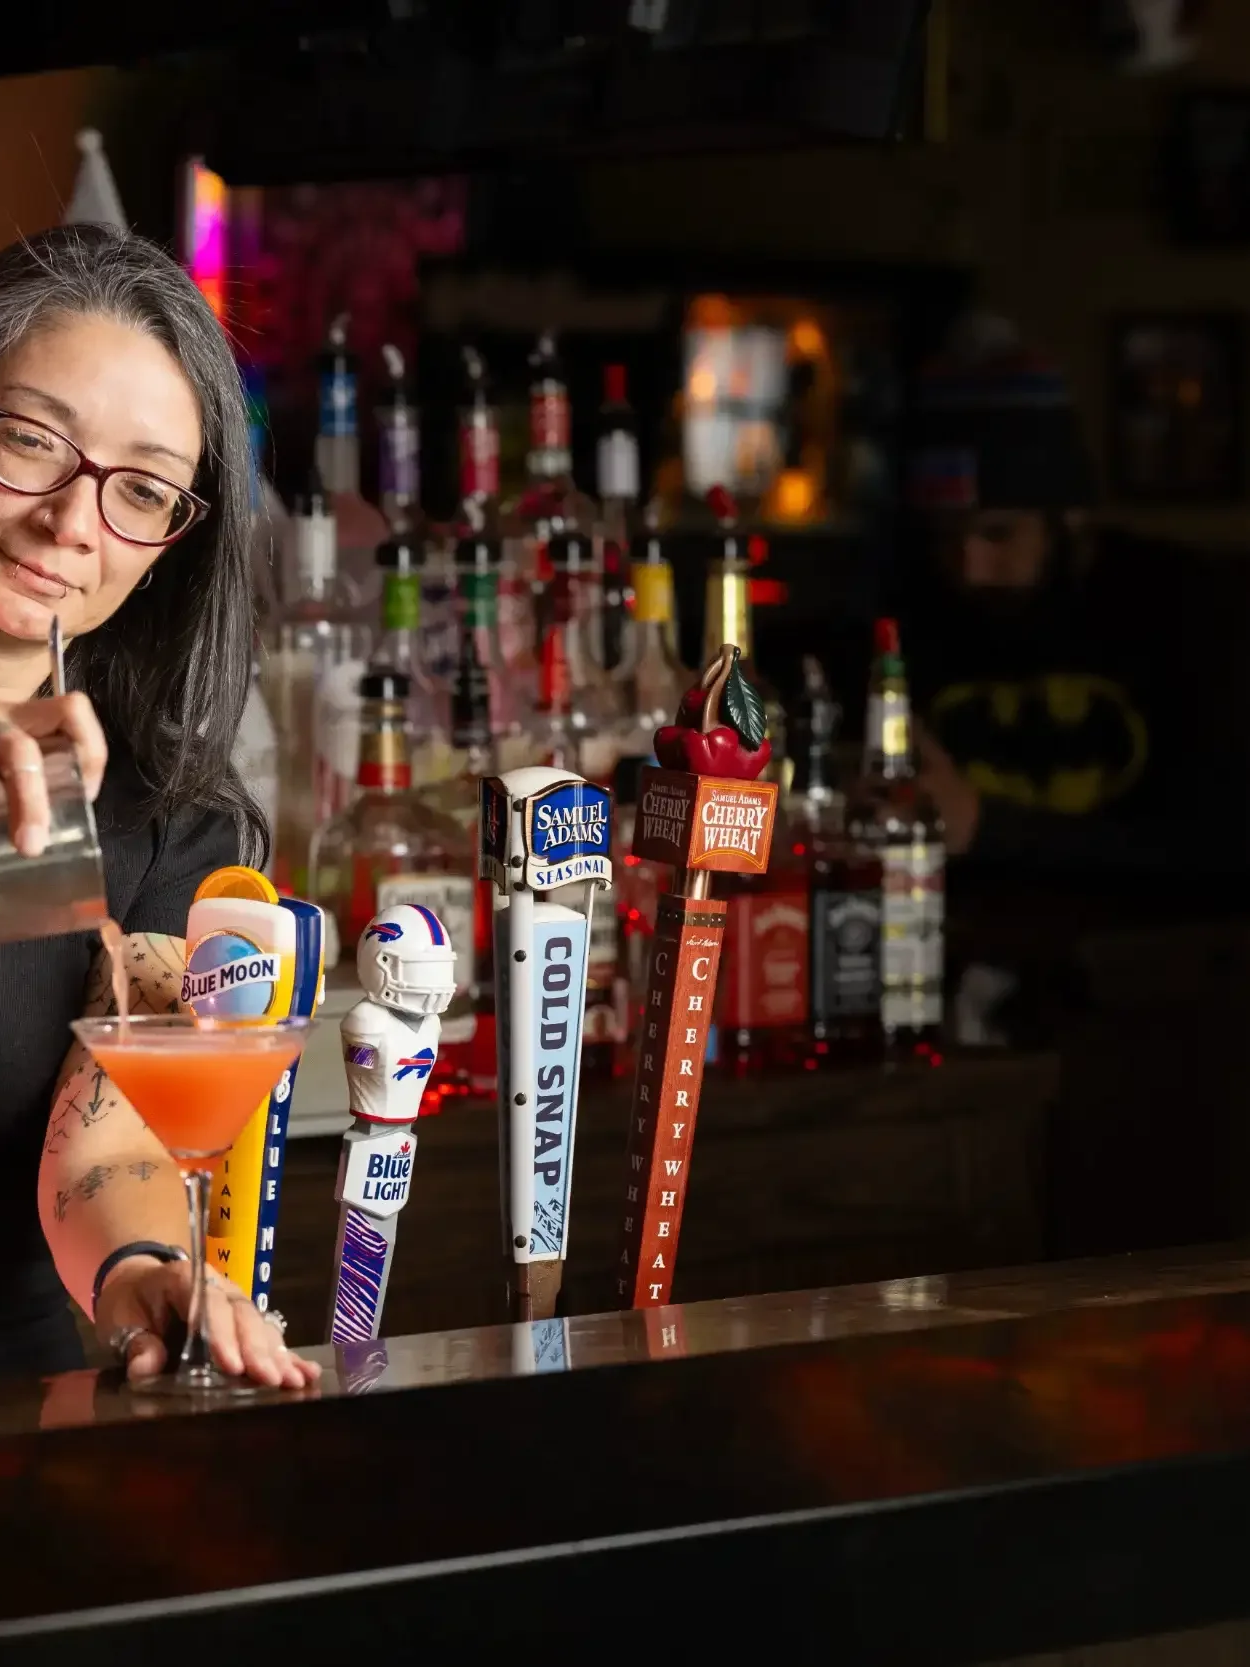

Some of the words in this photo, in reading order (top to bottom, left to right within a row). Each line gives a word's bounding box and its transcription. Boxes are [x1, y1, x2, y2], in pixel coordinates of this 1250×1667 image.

[642, 791, 690, 821] CHERRY
[711, 789, 737, 804] SAMUEL
[738, 793, 762, 806] ADAMS
[537, 801, 607, 830] SAMUEL
[701, 801, 768, 829] CHERRY
[542, 822, 603, 852] ADAMS
[643, 815, 685, 848] WHEAT
[703, 826, 761, 855] WHEAT
[536, 859, 605, 886] SEASONAL
[181, 974, 216, 1003] BLUE
[220, 959, 274, 989] MOON
[540, 936, 572, 1052] COLD
[636, 952, 668, 1134] CHERRY
[671, 956, 710, 1140] CHERRY
[264, 1069, 292, 1202] BLUE
[533, 1064, 565, 1188] SNAP
[366, 1153, 411, 1179] Blue
[362, 1180, 408, 1201] LIGHT
[649, 1159, 683, 1300] WHEAT
[255, 1226, 275, 1314] MOO
